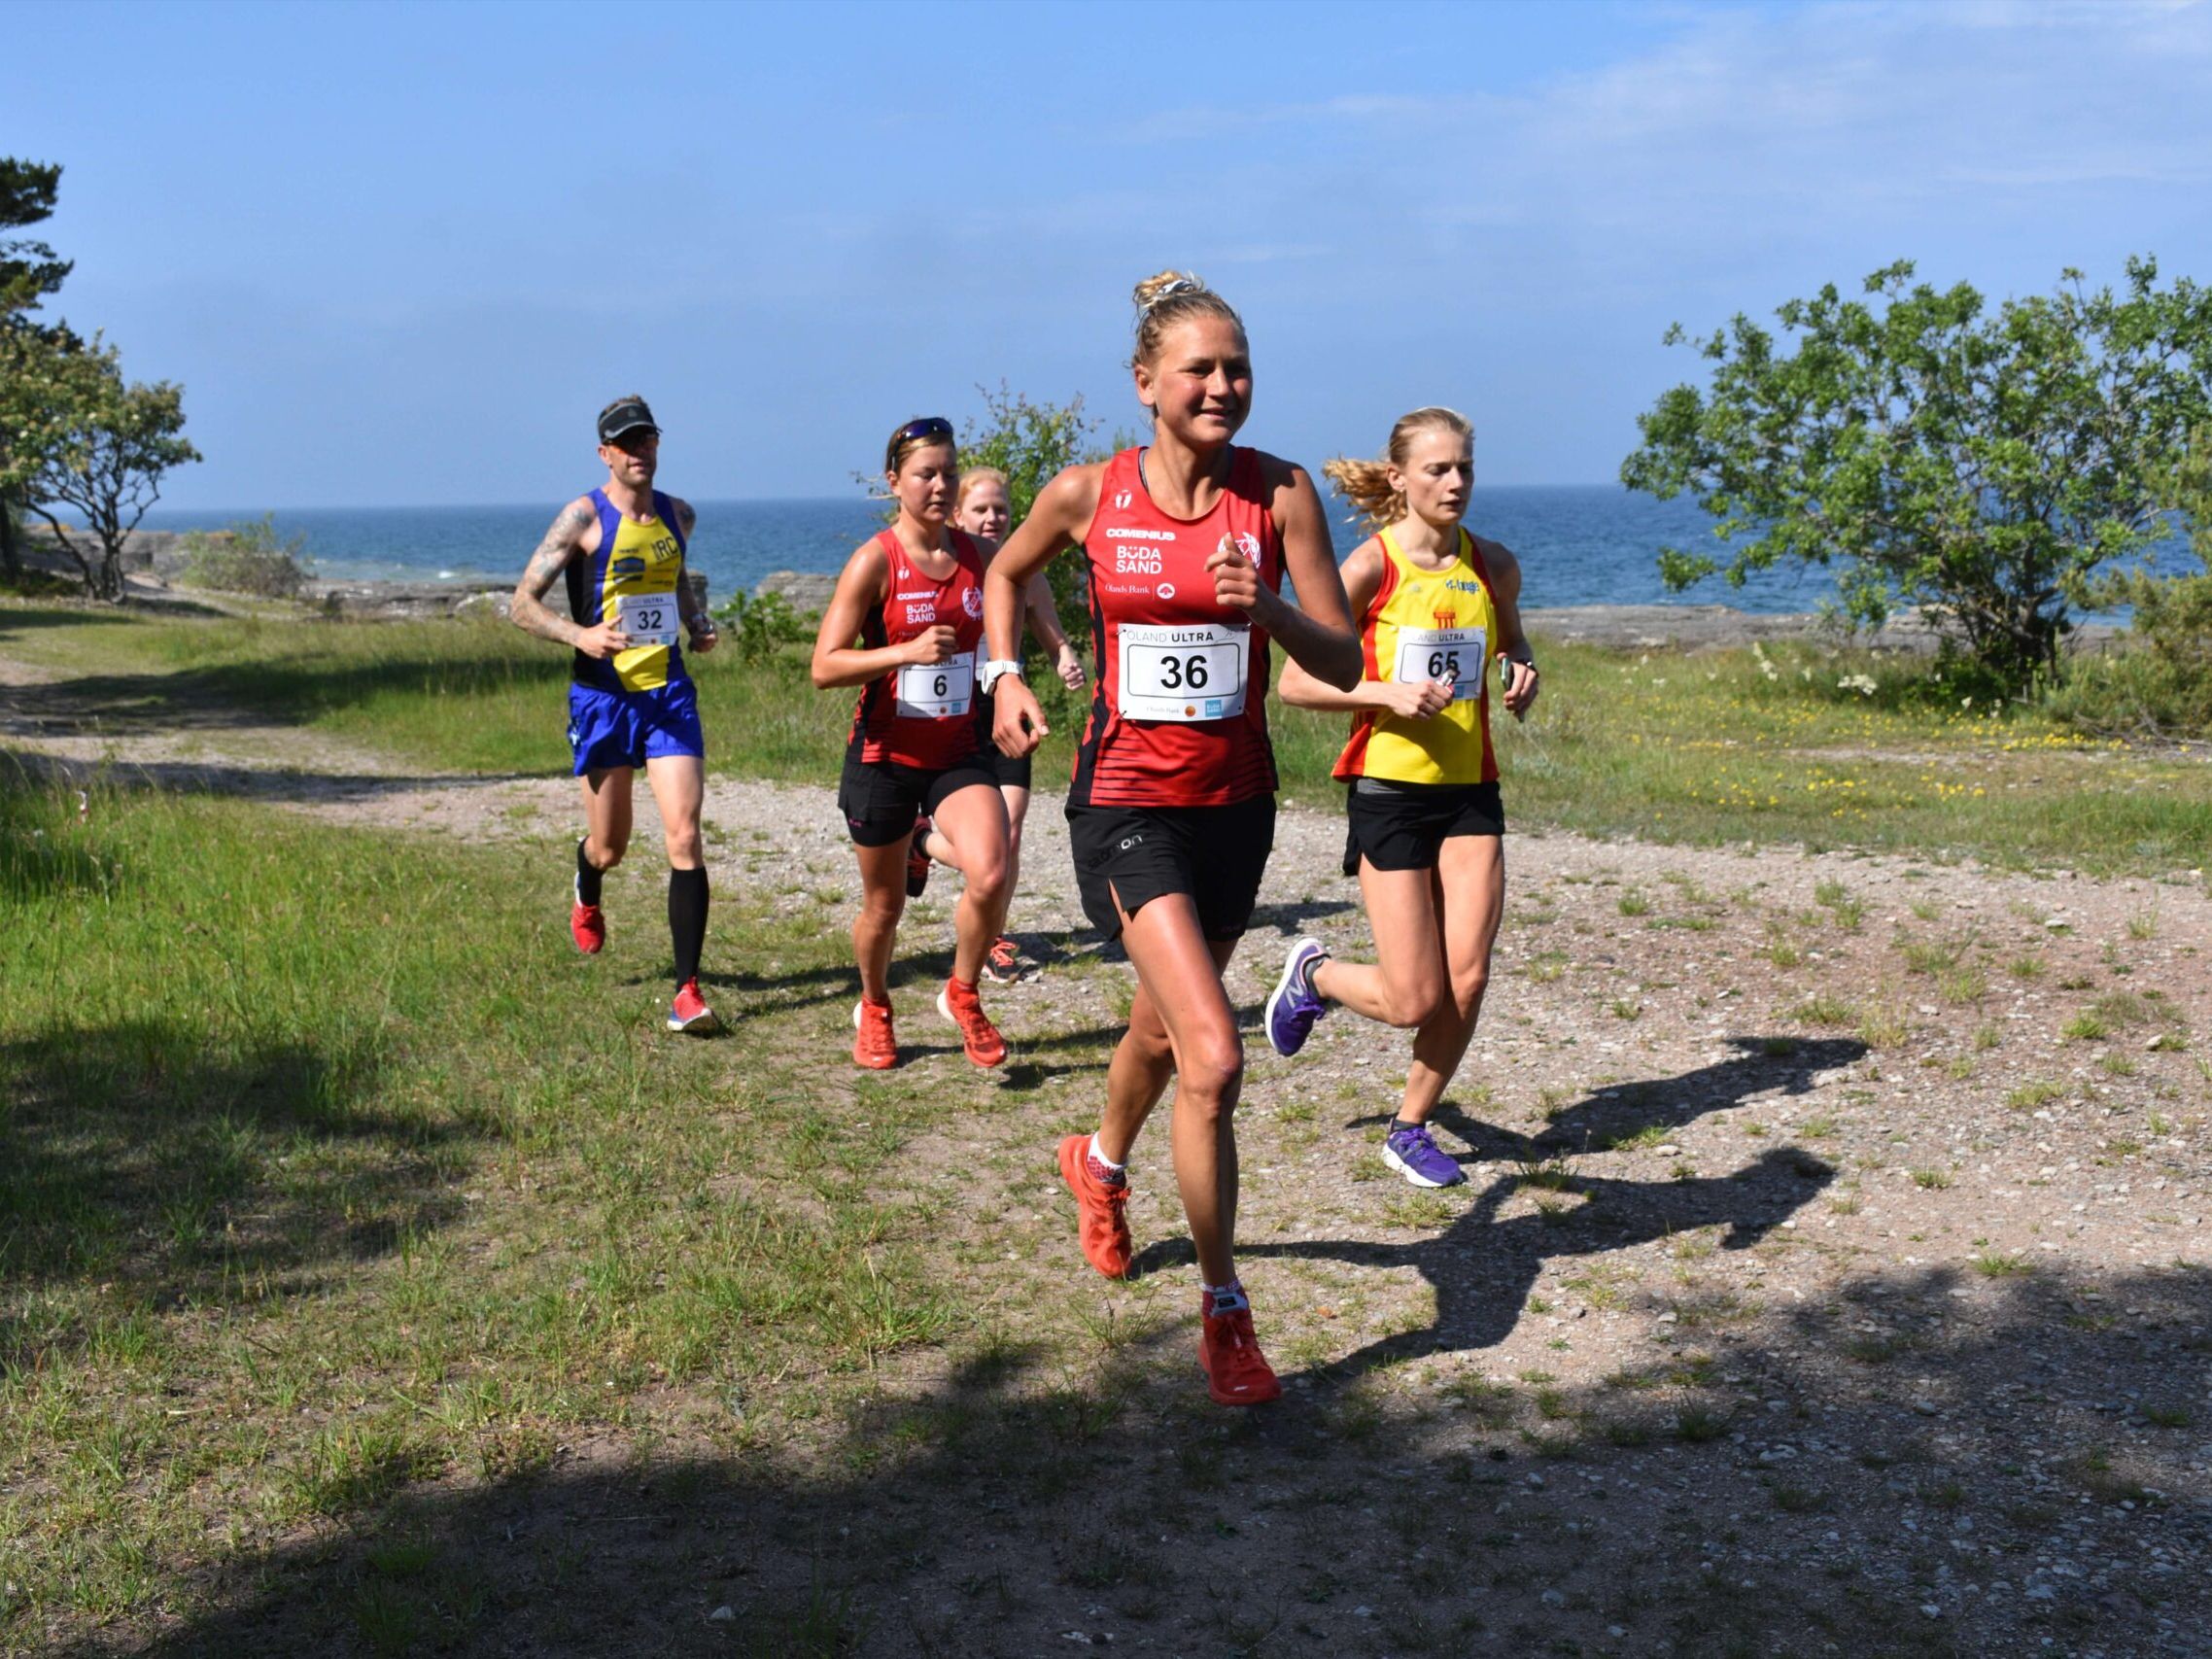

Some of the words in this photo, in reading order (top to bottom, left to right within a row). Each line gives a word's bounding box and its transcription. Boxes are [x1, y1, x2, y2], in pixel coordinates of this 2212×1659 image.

[1106, 528, 1176, 541] COMENIUS
[1116, 561, 1162, 574] SAND
[1128, 584, 1151, 595] Bank
[638, 610, 662, 630] 32
[907, 612, 936, 625] SAND
[1171, 632, 1214, 642] ULTRA
[1439, 633, 1465, 641] ULTRA
[1428, 651, 1460, 677] 65
[1160, 655, 1208, 689] 36
[934, 674, 947, 697] 6
